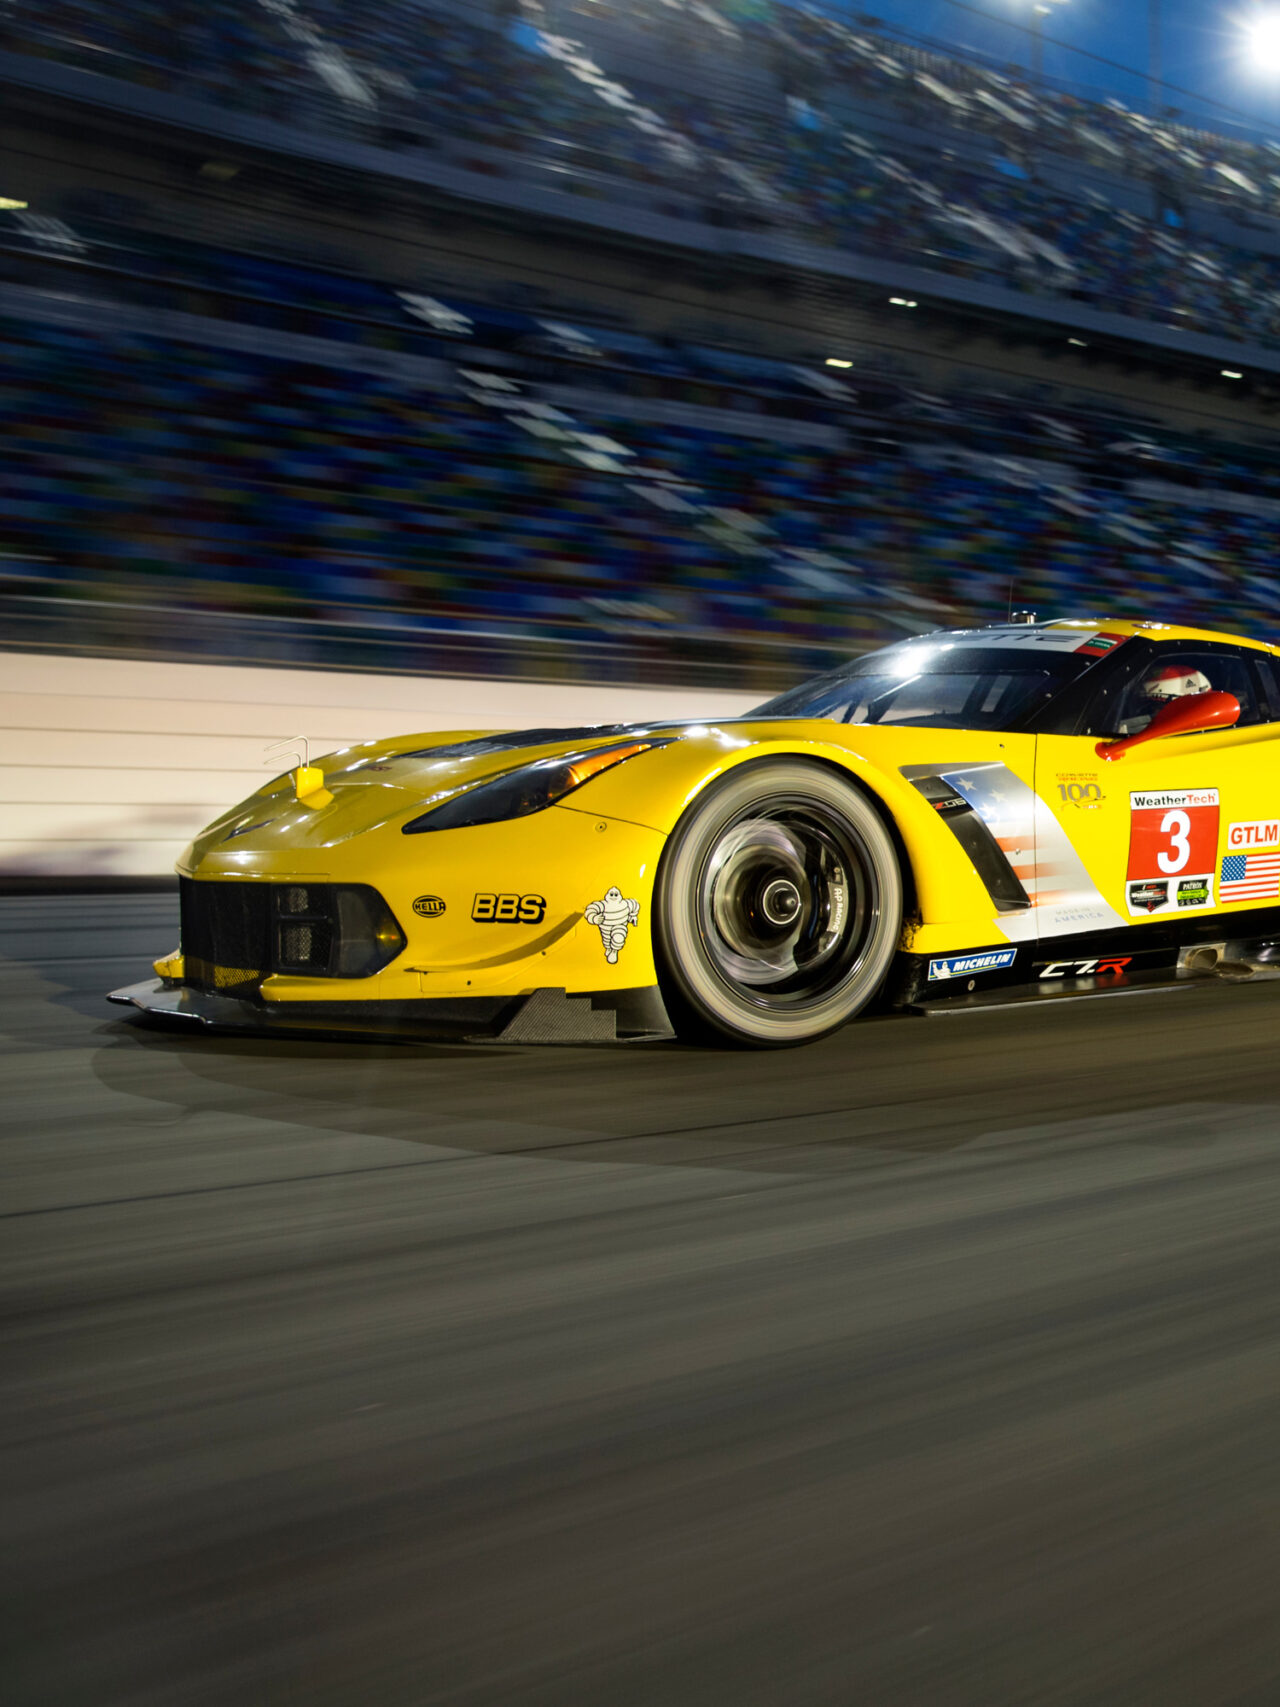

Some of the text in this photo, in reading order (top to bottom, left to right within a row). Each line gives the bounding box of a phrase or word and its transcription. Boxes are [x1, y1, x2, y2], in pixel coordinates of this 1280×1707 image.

[1134, 794, 1215, 807] WeatherTech
[1157, 810, 1191, 874] 3
[1231, 825, 1279, 845] GTLM
[413, 900, 447, 914] HELLA
[471, 893, 547, 924] BBS
[952, 953, 1012, 972] MICHELIN
